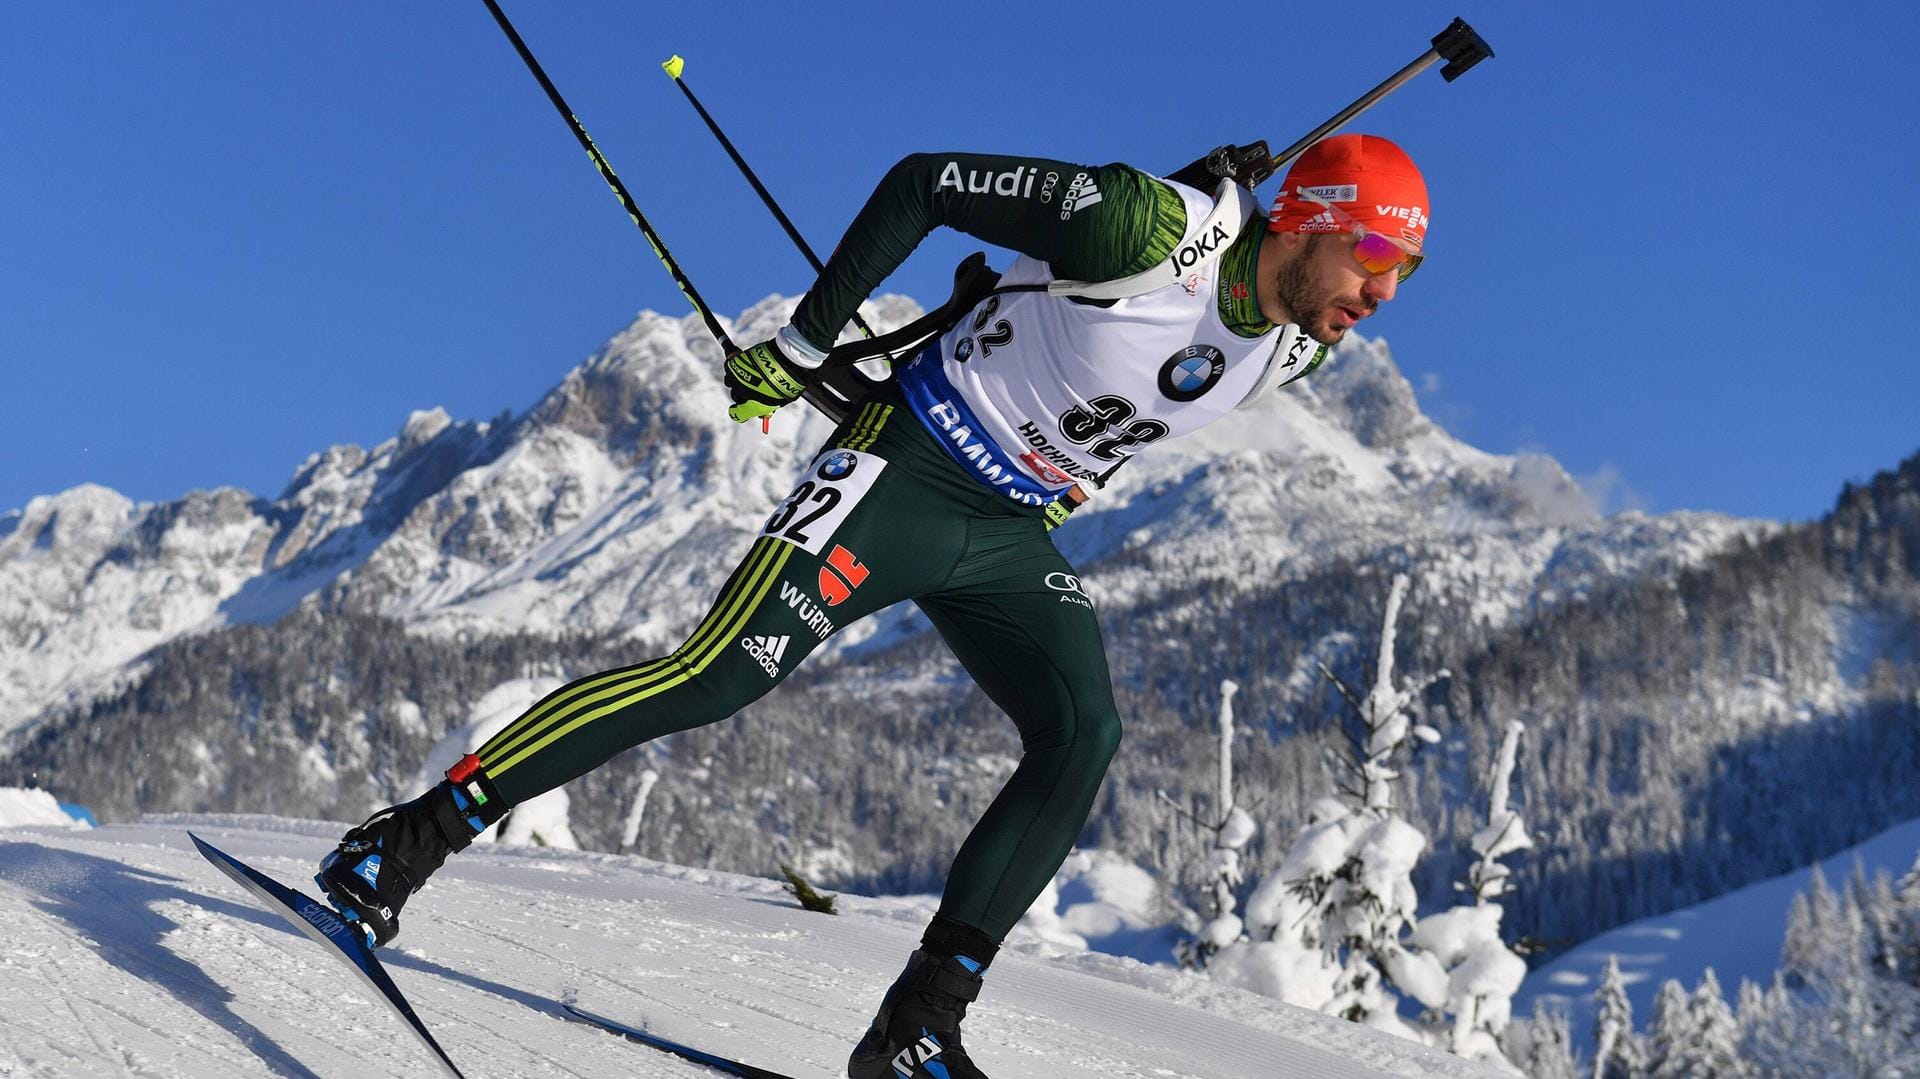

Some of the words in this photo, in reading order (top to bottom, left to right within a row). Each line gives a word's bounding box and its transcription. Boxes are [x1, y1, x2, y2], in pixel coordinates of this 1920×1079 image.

[936, 161, 1038, 199] Audi
[1060, 172, 1088, 221] adidas
[1299, 222, 1341, 231] adidas
[1170, 225, 1230, 278] JOKA
[973, 294, 1014, 359] 32
[755, 347, 777, 375] WAY
[1185, 346, 1224, 375] BMW
[1280, 335, 1309, 369] KA
[774, 374, 800, 395] ONE
[928, 400, 1013, 486] BMW
[1058, 394, 1170, 462] 32
[765, 481, 842, 545] 32
[779, 580, 834, 640] WÜRTH
[1060, 595, 1092, 610] Audi
[741, 637, 779, 678] adidas
[299, 903, 345, 937] salomon
